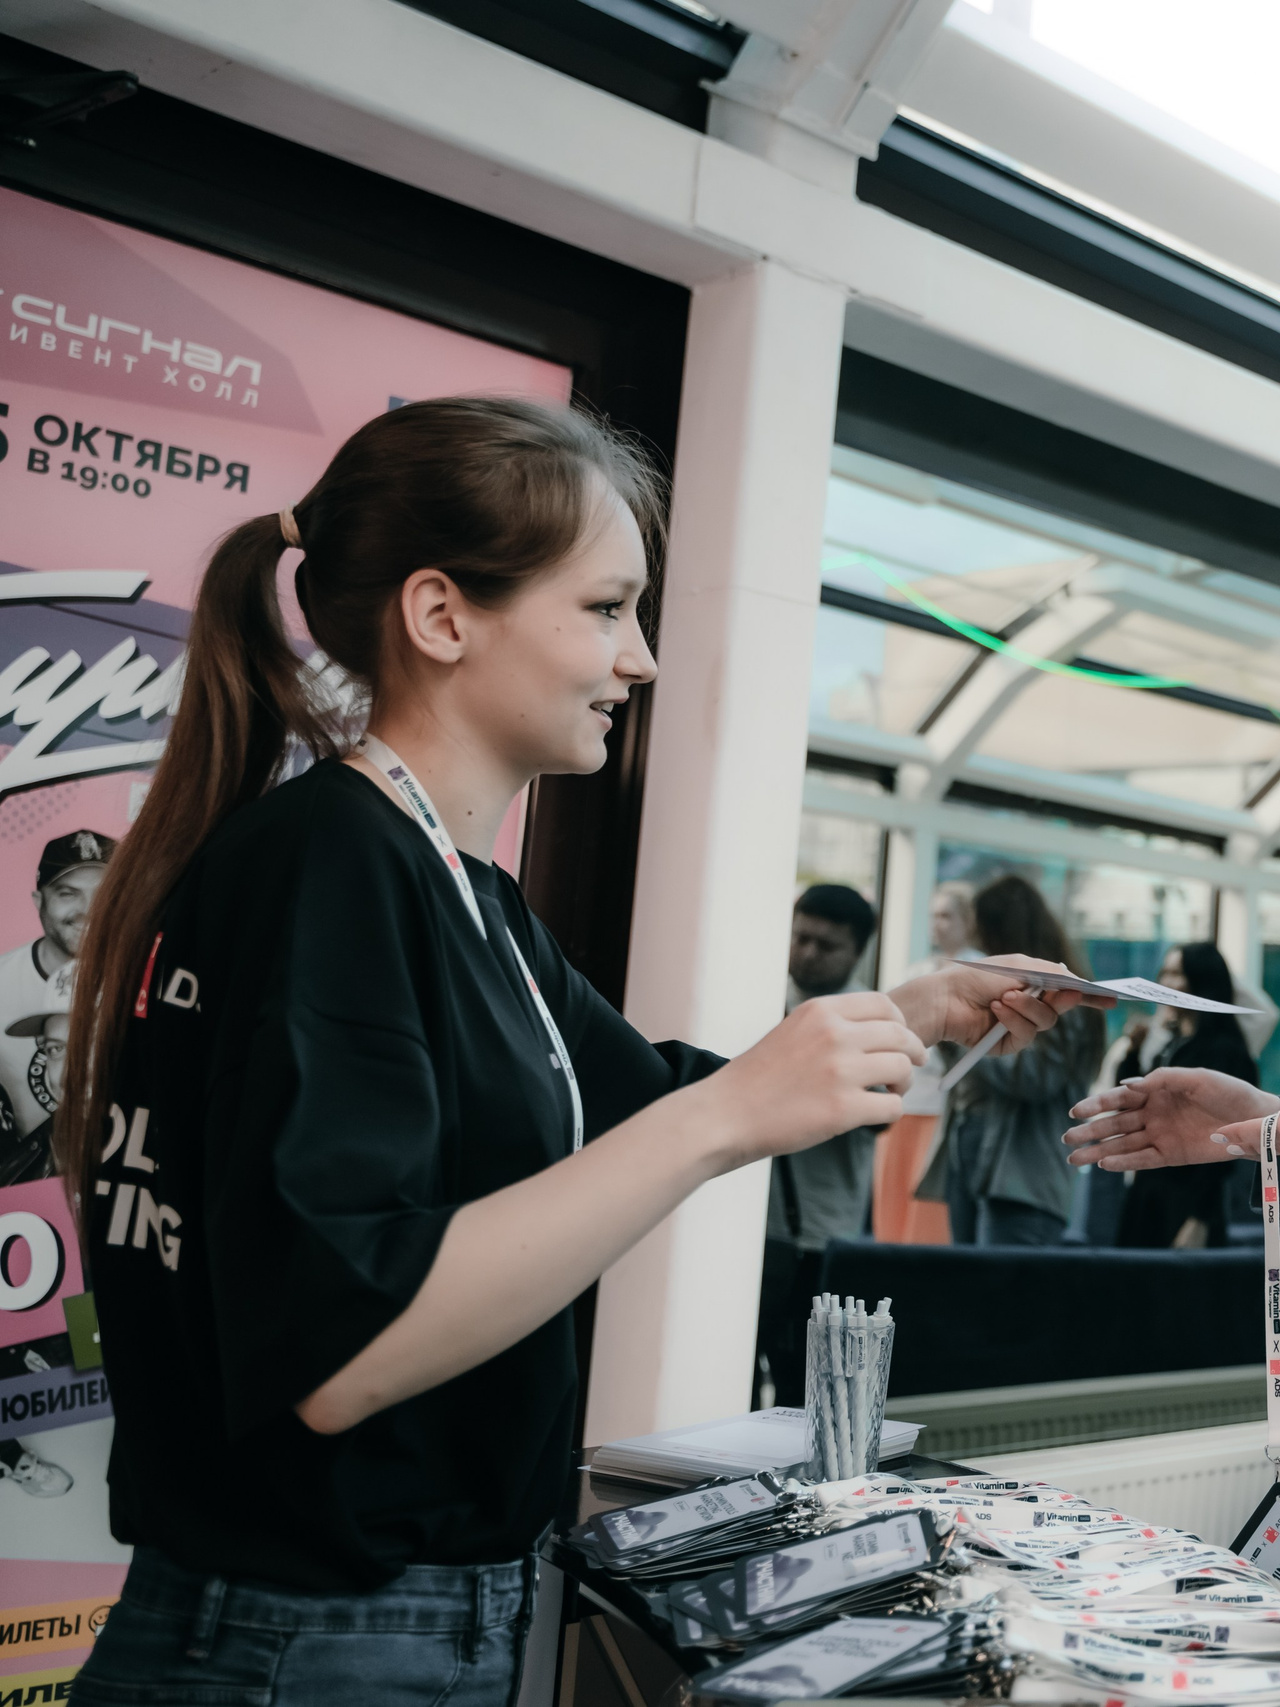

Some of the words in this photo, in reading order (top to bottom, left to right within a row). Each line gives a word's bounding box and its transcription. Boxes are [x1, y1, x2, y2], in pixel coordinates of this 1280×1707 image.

[9, 323, 139, 373] ИВЕНТ
[162, 367, 259, 408] ХОЛЛ
[33, 415, 251, 494] ОКТЯБРЯ
[27, 448, 50, 475] В
[60, 460, 152, 499] 19:00
[401, 777, 428, 816] Vitamin
[1265, 1115, 1276, 1149] Vitamin
[1272, 1283, 1280, 1319] Vitamin
[1273, 1378, 1280, 1398] ADS
[974, 1482, 1004, 1490] Vitamin
[975, 1512, 991, 1520] ADS
[1046, 1512, 1077, 1522] Vitamin
[1208, 1594, 1247, 1603] Vitamin
